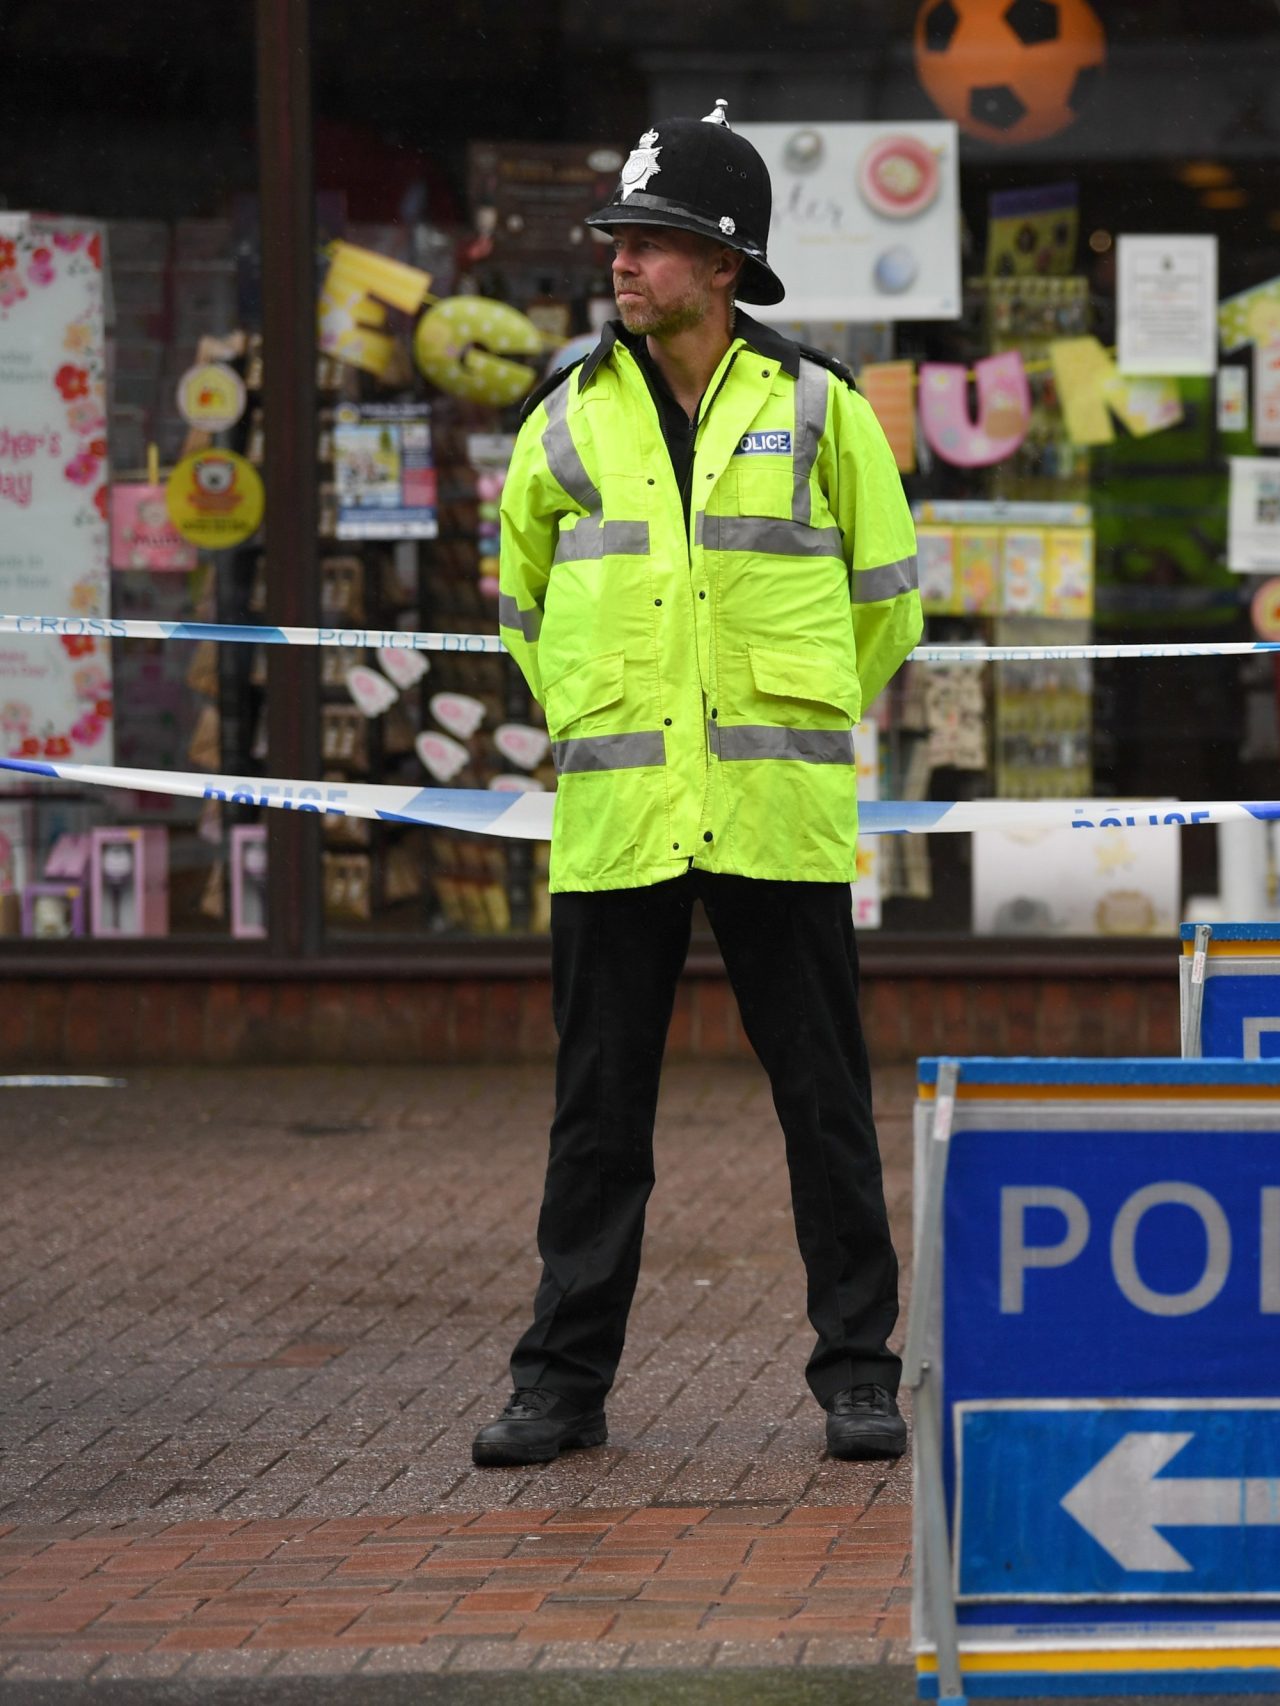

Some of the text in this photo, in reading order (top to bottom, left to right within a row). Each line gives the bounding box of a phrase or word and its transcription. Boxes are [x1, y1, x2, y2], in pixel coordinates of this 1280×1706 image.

[740, 434, 787, 451] OLICE
[16, 615, 128, 637] CROSS
[318, 628, 486, 652] POLICE DO
